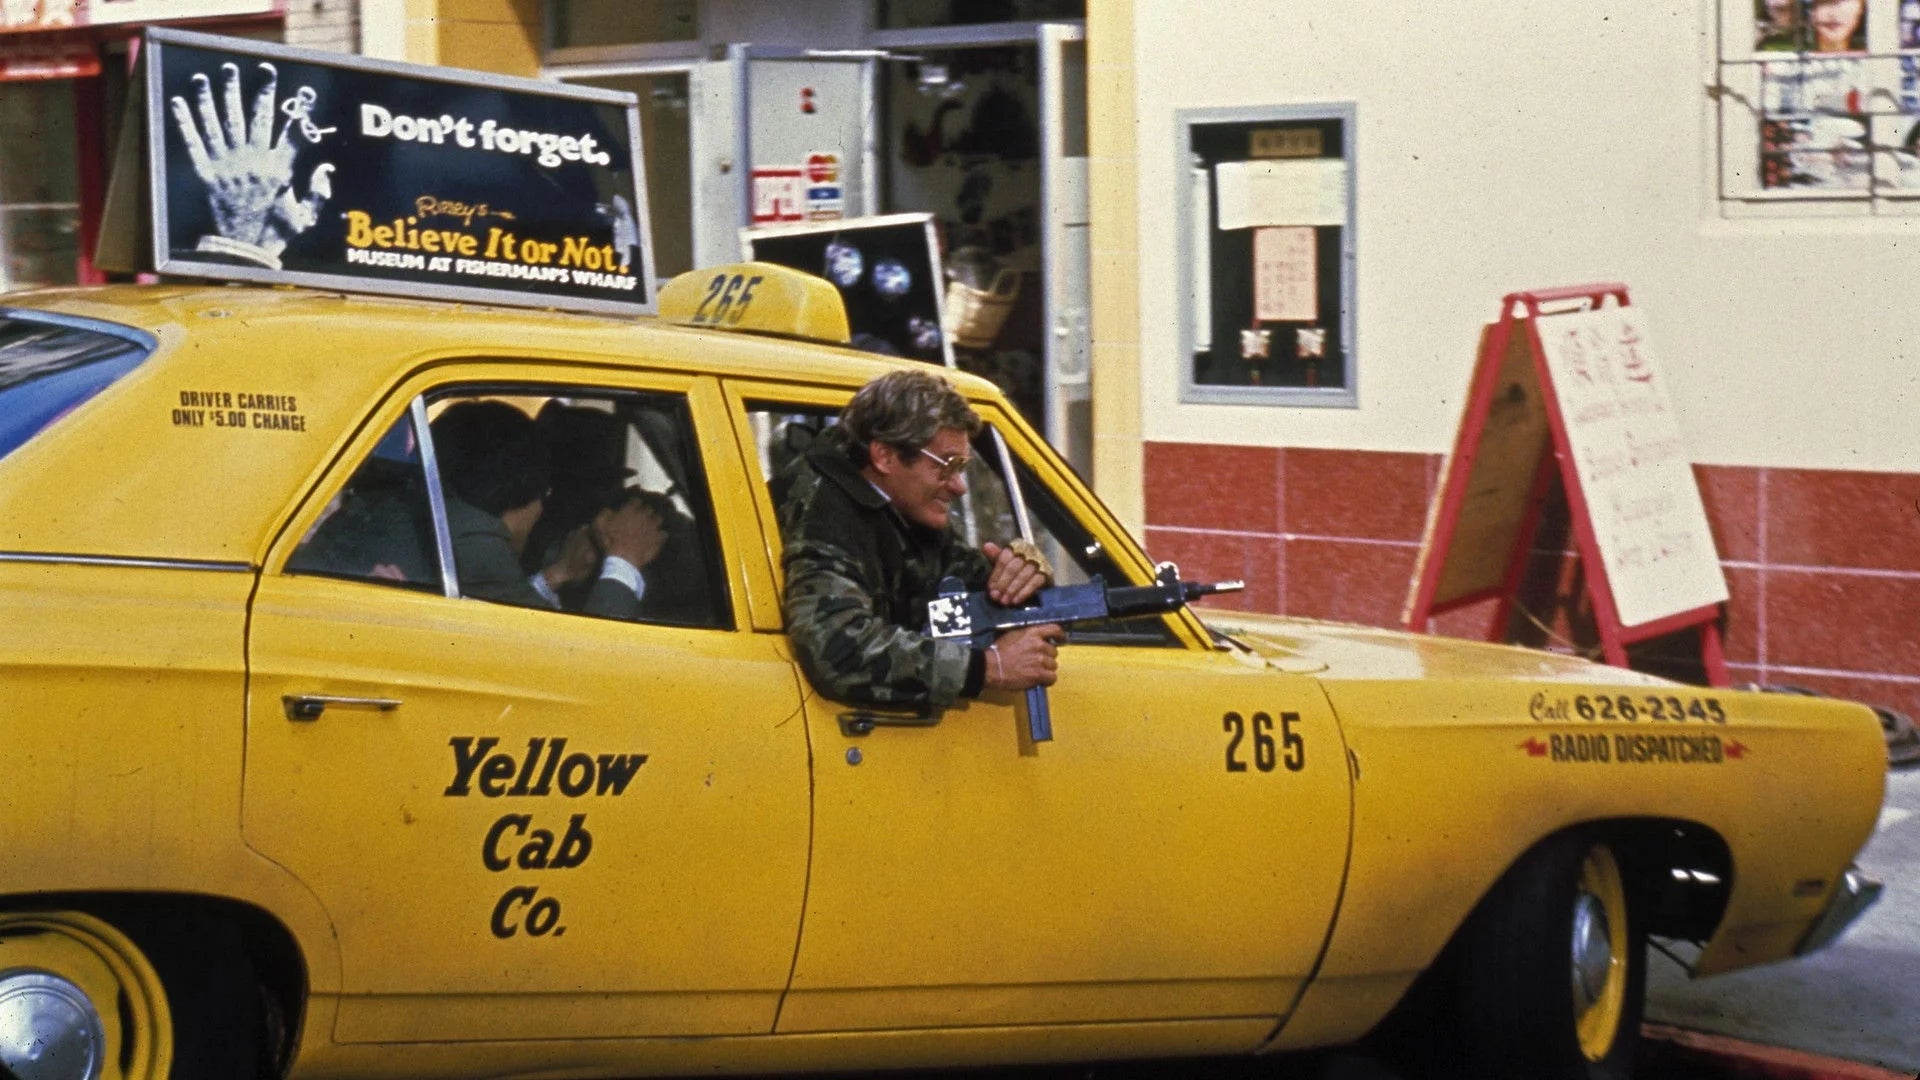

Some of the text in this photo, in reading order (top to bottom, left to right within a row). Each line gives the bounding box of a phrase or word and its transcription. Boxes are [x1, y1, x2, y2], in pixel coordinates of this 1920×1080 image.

[360, 103, 611, 168] Don't forget.
[346, 210, 479, 257] Believe
[484, 227, 518, 261] It
[521, 239, 558, 264] or
[346, 248, 638, 291] MUSEUM AT FISHERMAN'S WHARF
[693, 273, 764, 325] 265
[172, 408, 205, 427] ONLY
[252, 412, 307, 432] CHANGE
[179, 390, 298, 412] DRIVER CARRIES
[1529, 692, 1726, 724] Call 626-2345
[443, 736, 649, 798] Yellow
[1222, 710, 1305, 773] 265
[1550, 732, 1724, 765] RADIO DISPATCHED
[482, 812, 593, 873] Cab
[489, 885, 567, 940] Co.
